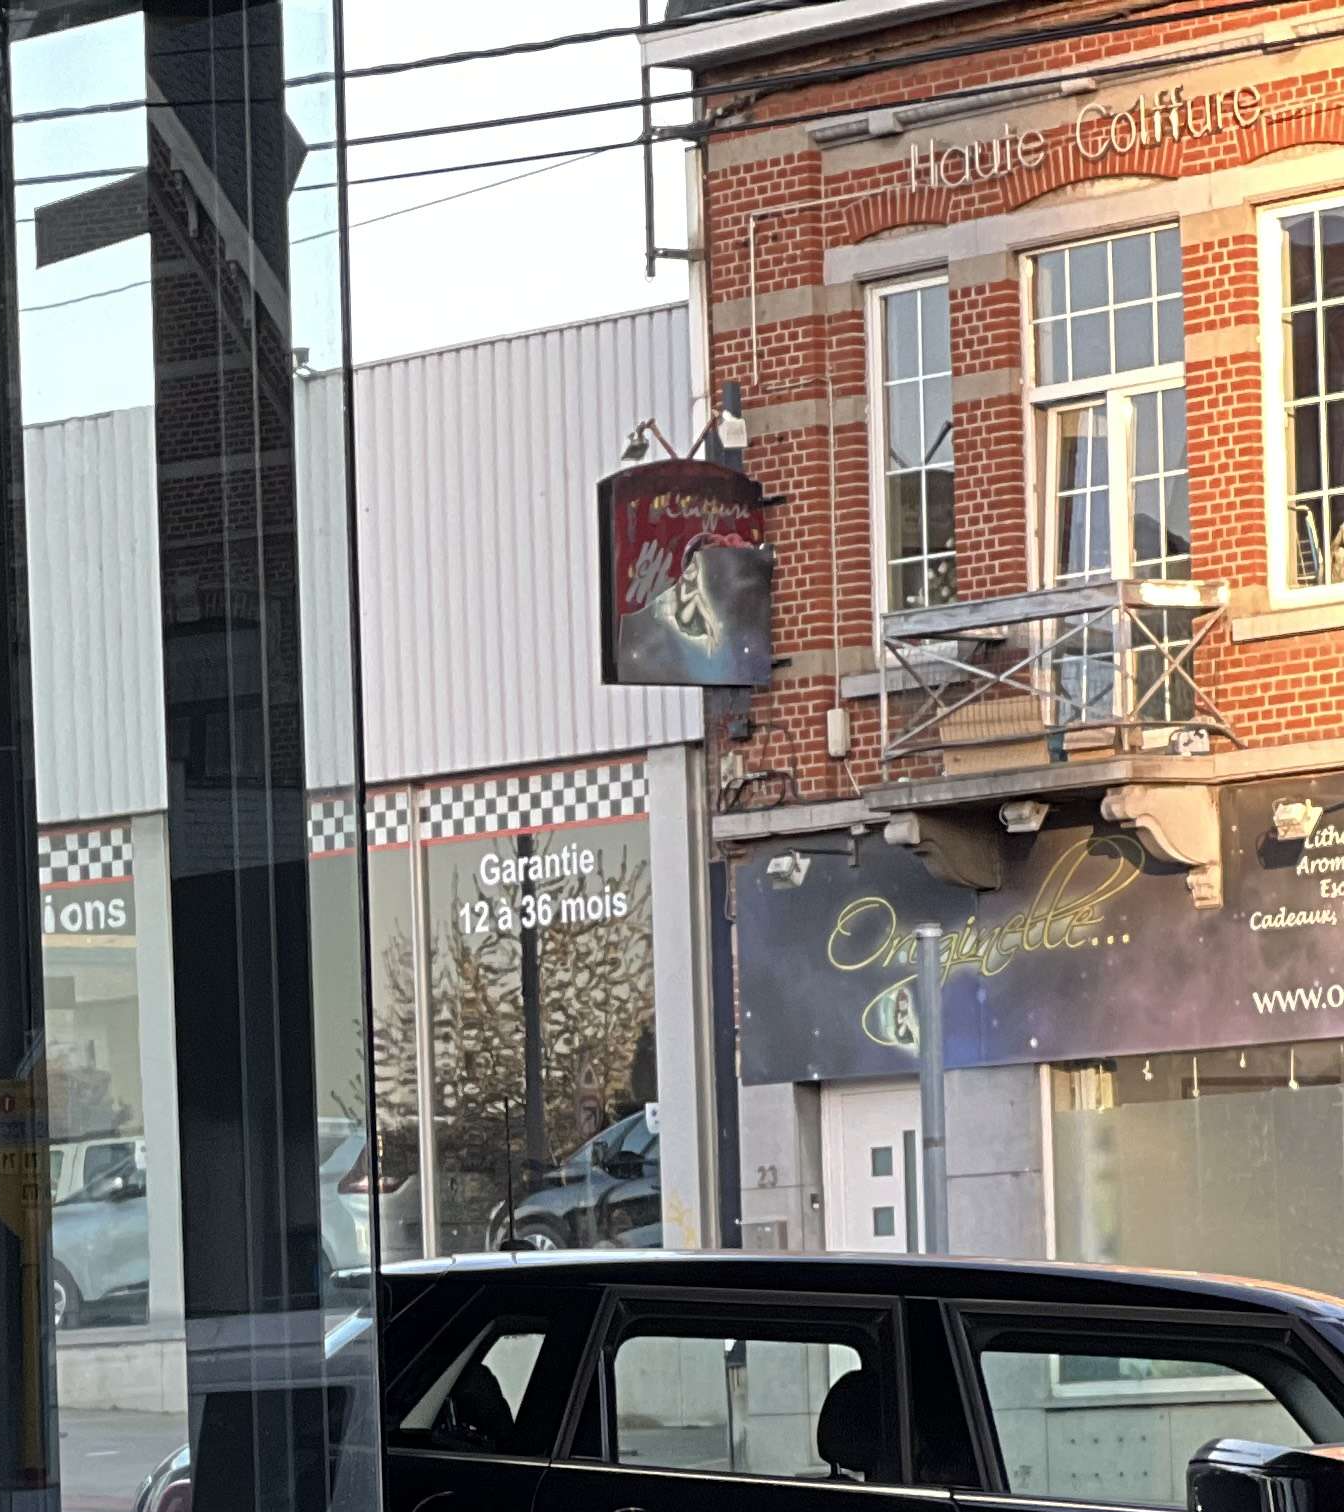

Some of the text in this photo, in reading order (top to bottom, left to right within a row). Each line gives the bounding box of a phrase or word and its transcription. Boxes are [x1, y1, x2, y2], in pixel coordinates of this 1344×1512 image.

[910, 84, 1263, 193] Haute Coiffure
[480, 843, 595, 886] Garantie
[459, 885, 628, 934] 12 à 36 mois
